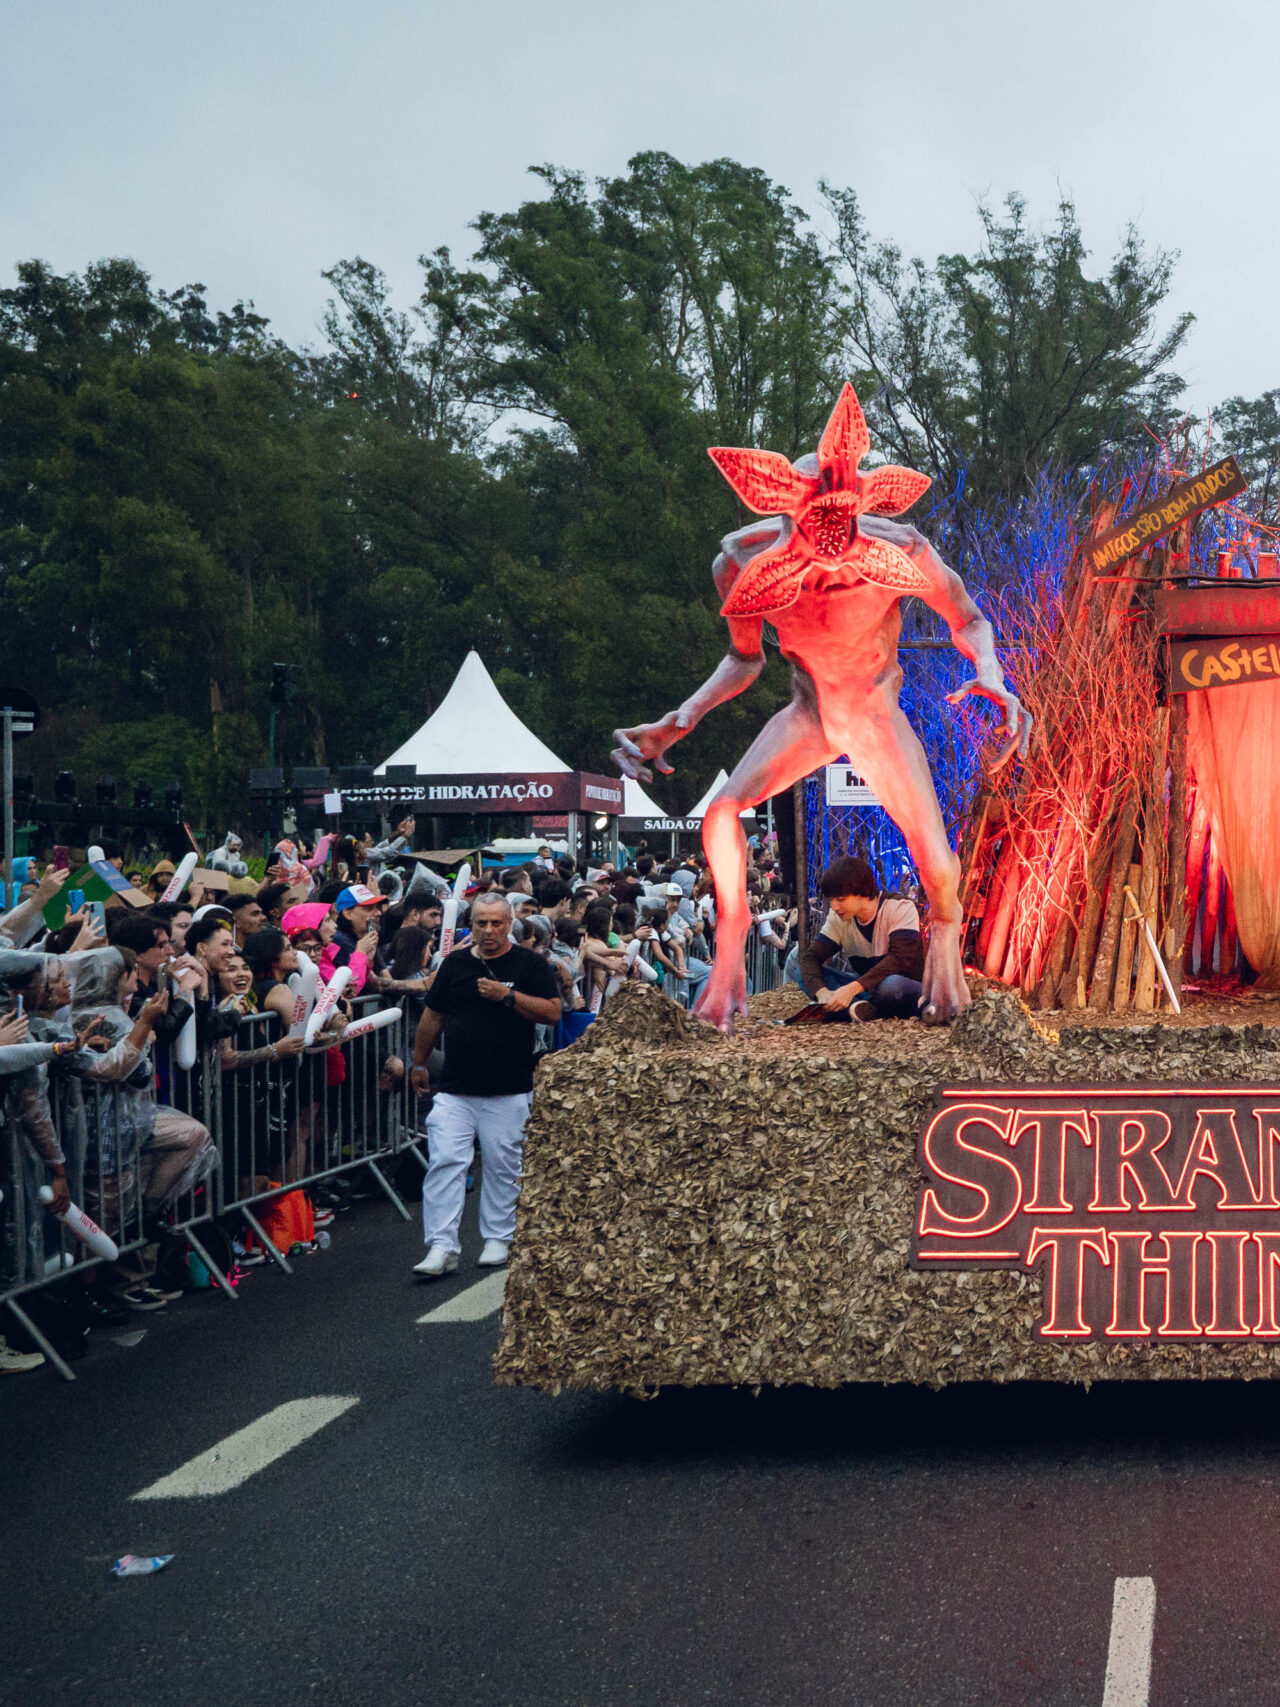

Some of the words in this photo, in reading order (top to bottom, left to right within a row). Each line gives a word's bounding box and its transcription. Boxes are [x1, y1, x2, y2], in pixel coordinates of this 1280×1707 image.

[1092, 528, 1140, 570] AMIGOS
[1136, 512, 1162, 538] SÃO
[1160, 462, 1236, 525] BEM-VINDOS
[429, 781, 554, 802] HIDRATAÇÃO
[644, 818, 684, 830] SAÍDA
[686, 820, 701, 830] 07
